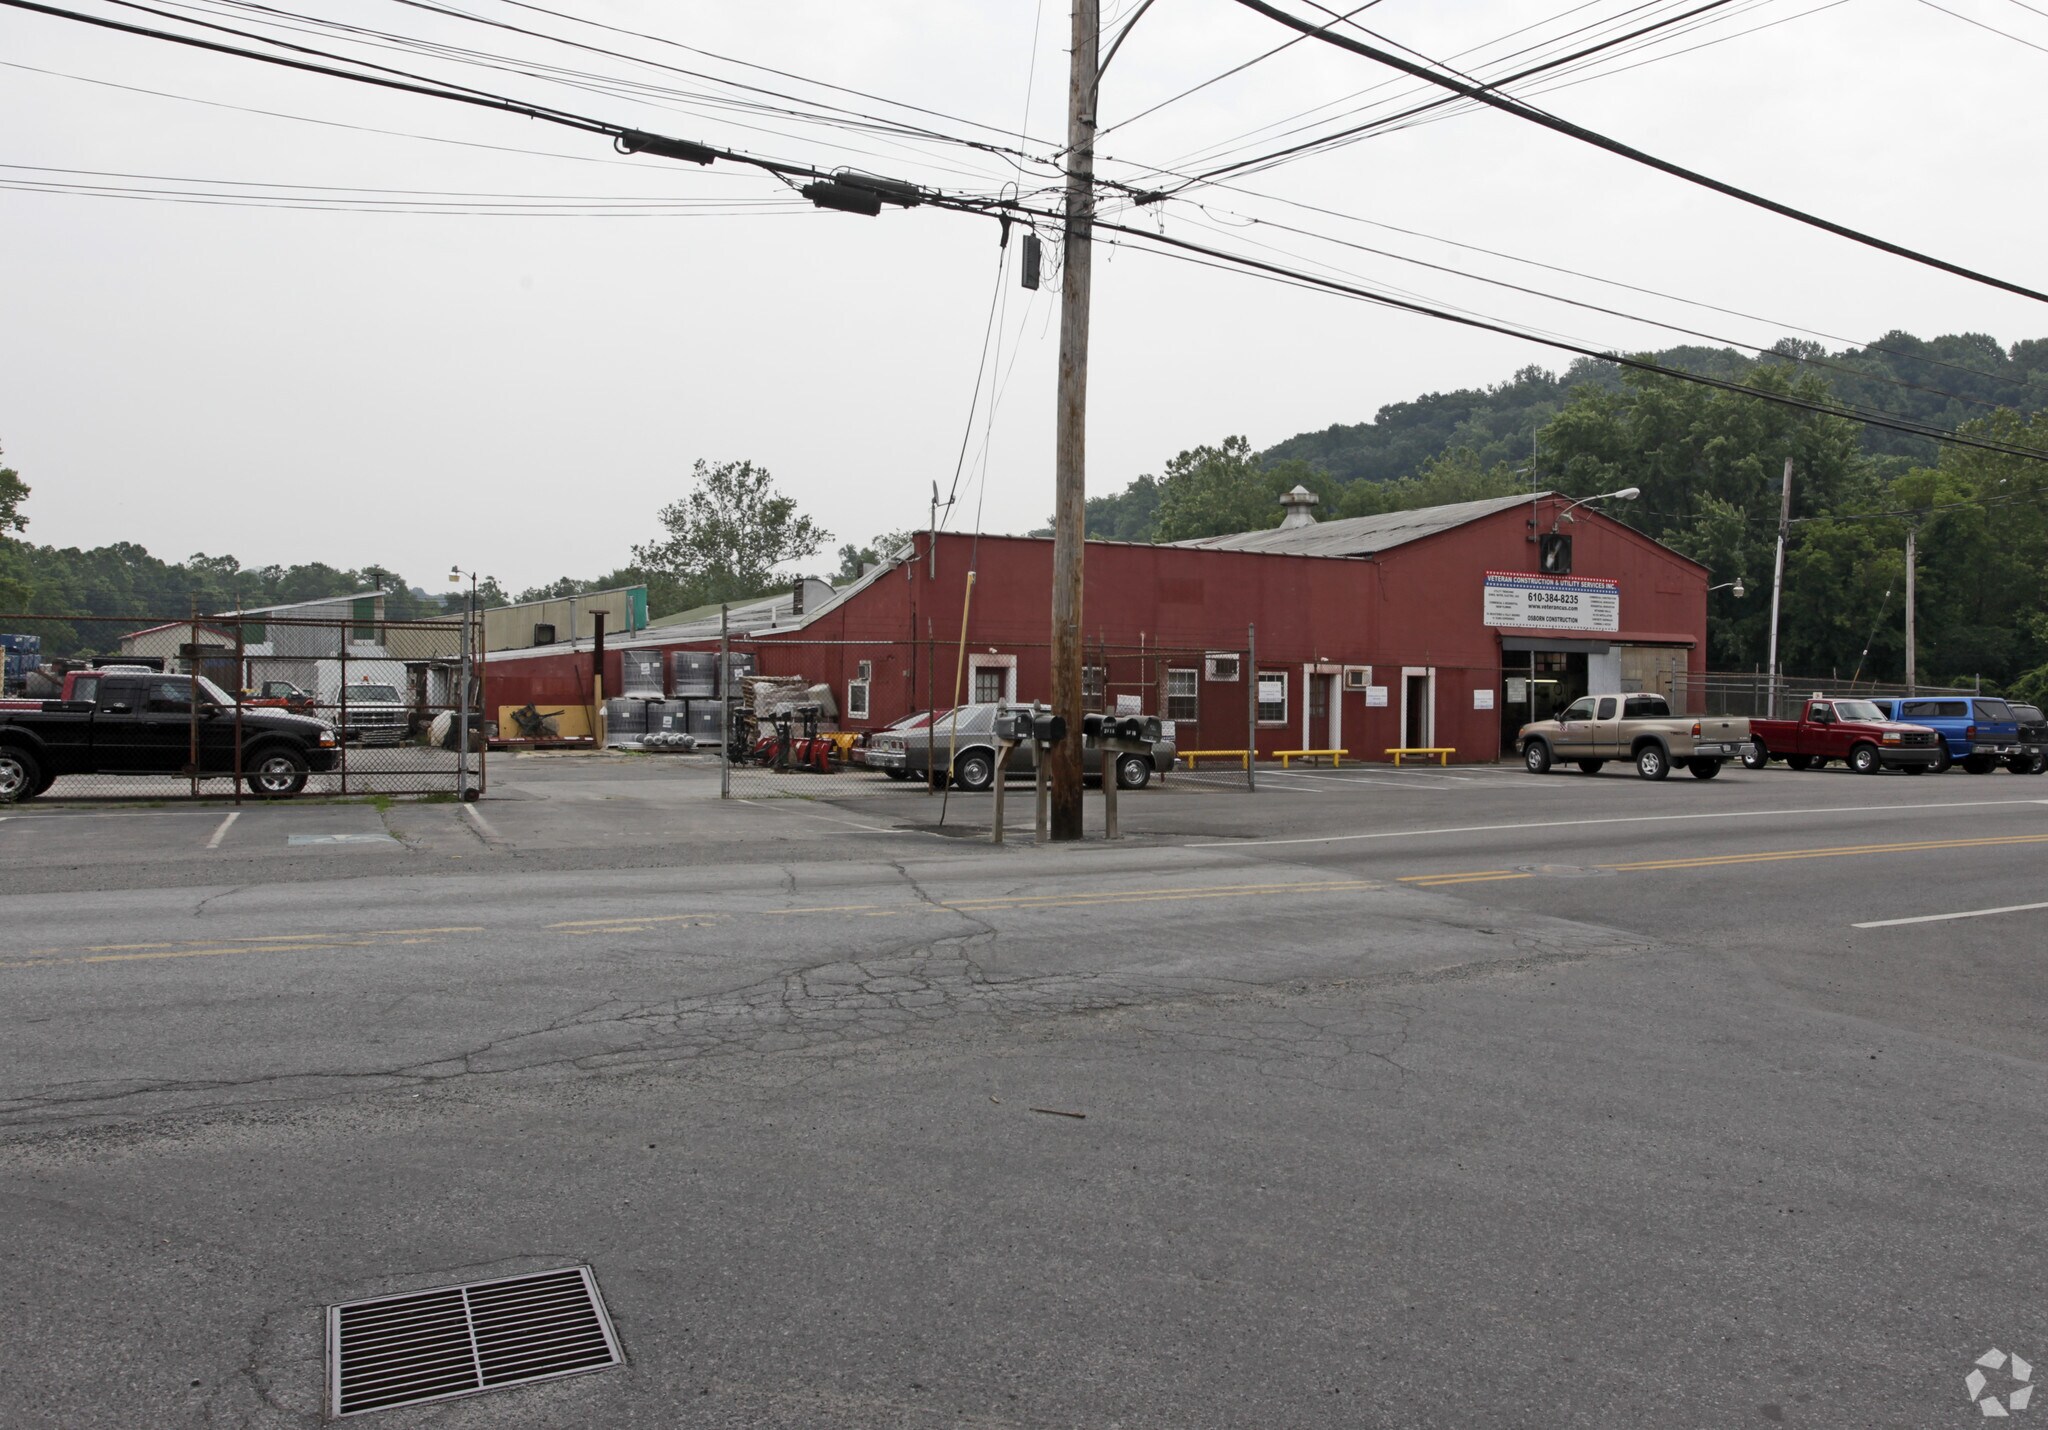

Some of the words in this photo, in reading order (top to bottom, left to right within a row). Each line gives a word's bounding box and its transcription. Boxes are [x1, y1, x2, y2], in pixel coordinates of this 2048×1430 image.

[1487, 575, 1512, 583] VETERAN
[1513, 577, 1554, 585] CONSTRUCTION
[1528, 592, 1578, 604] 610-384-8235
